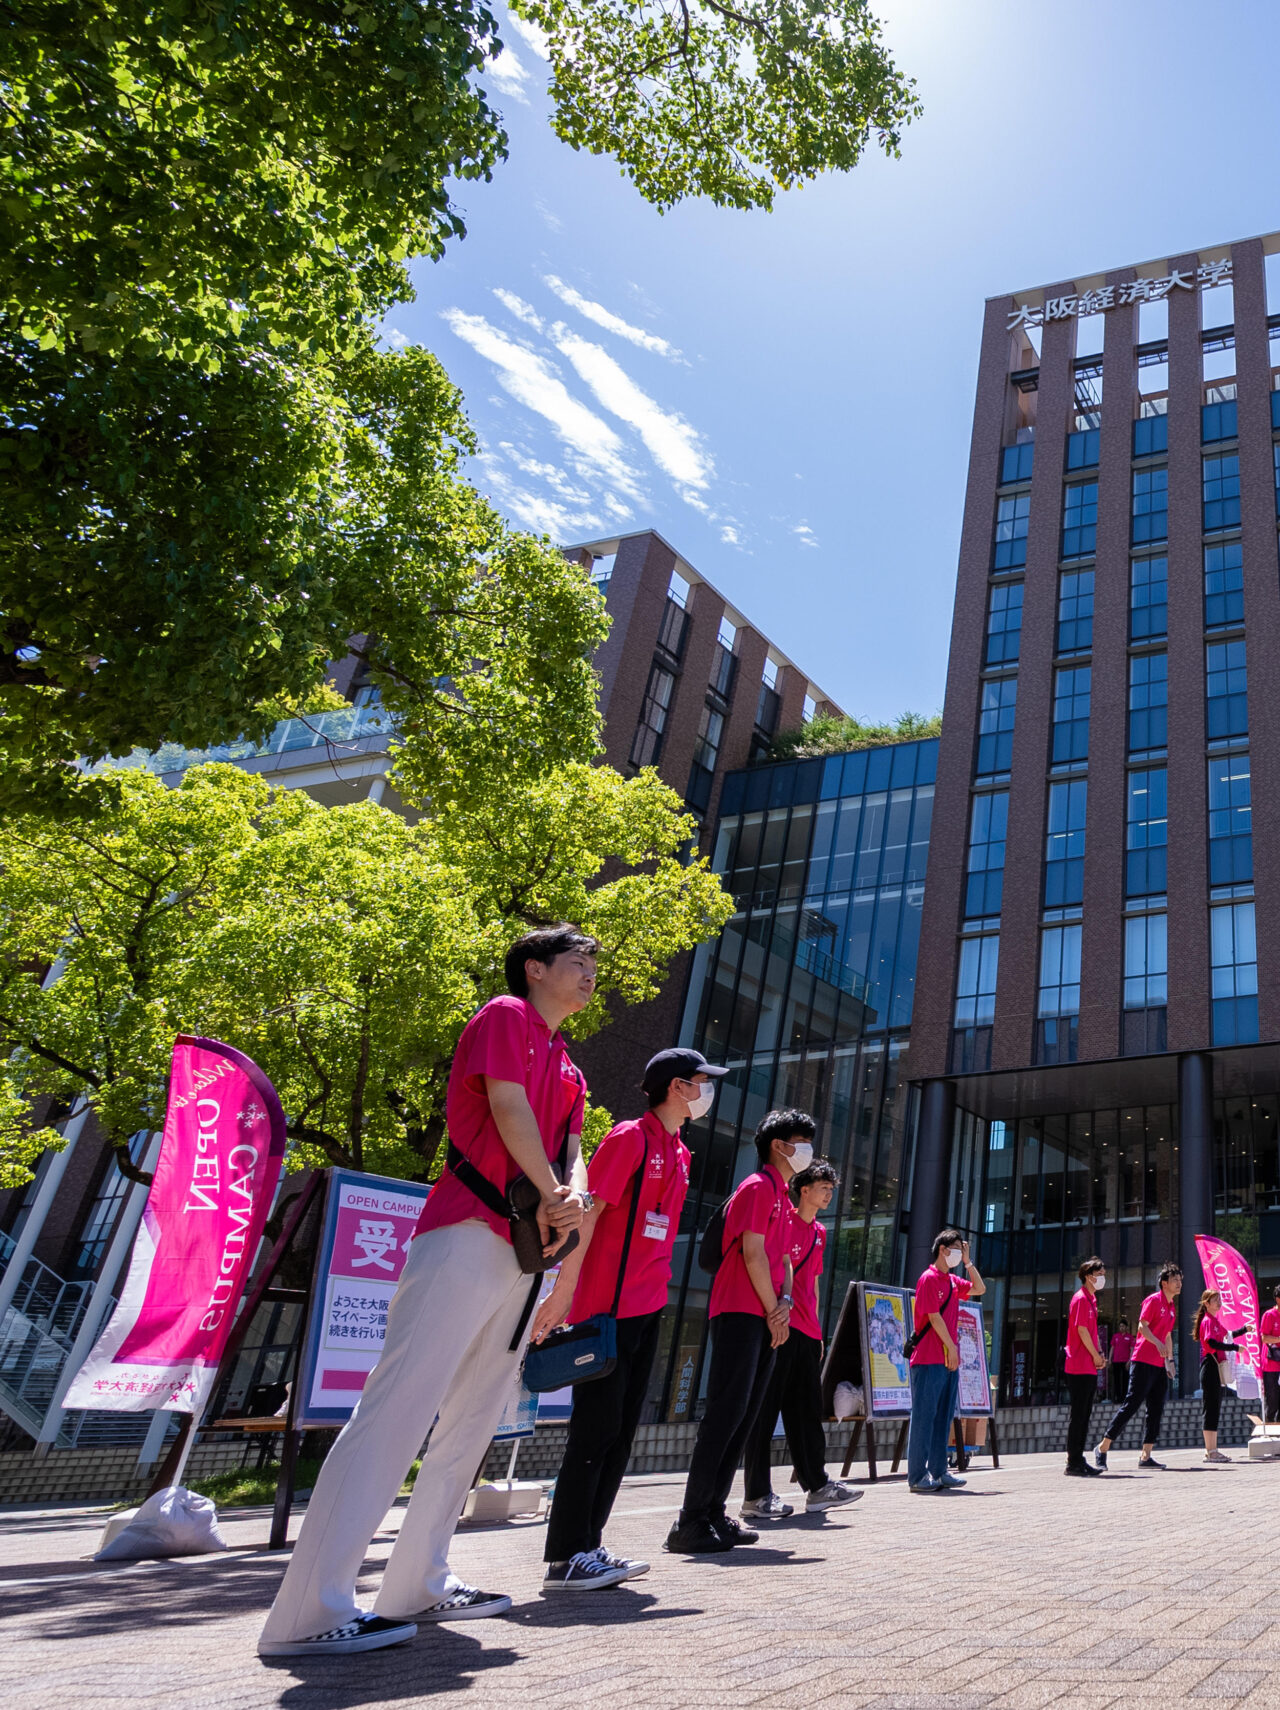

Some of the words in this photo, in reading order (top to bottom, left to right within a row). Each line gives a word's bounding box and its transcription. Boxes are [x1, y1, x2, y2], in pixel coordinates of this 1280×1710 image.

[1006, 258, 1233, 330] 大阪経済大学
[347, 1194, 380, 1210] OPEN
[382, 1200, 422, 1216] CAMPU
[351, 1219, 415, 1272] 受
[333, 1295, 390, 1311] ようこそ大阪
[331, 1310, 388, 1327] マイページ画
[328, 1324, 386, 1340] 続きを行いま
[674, 1355, 694, 1414] 人間科学部
